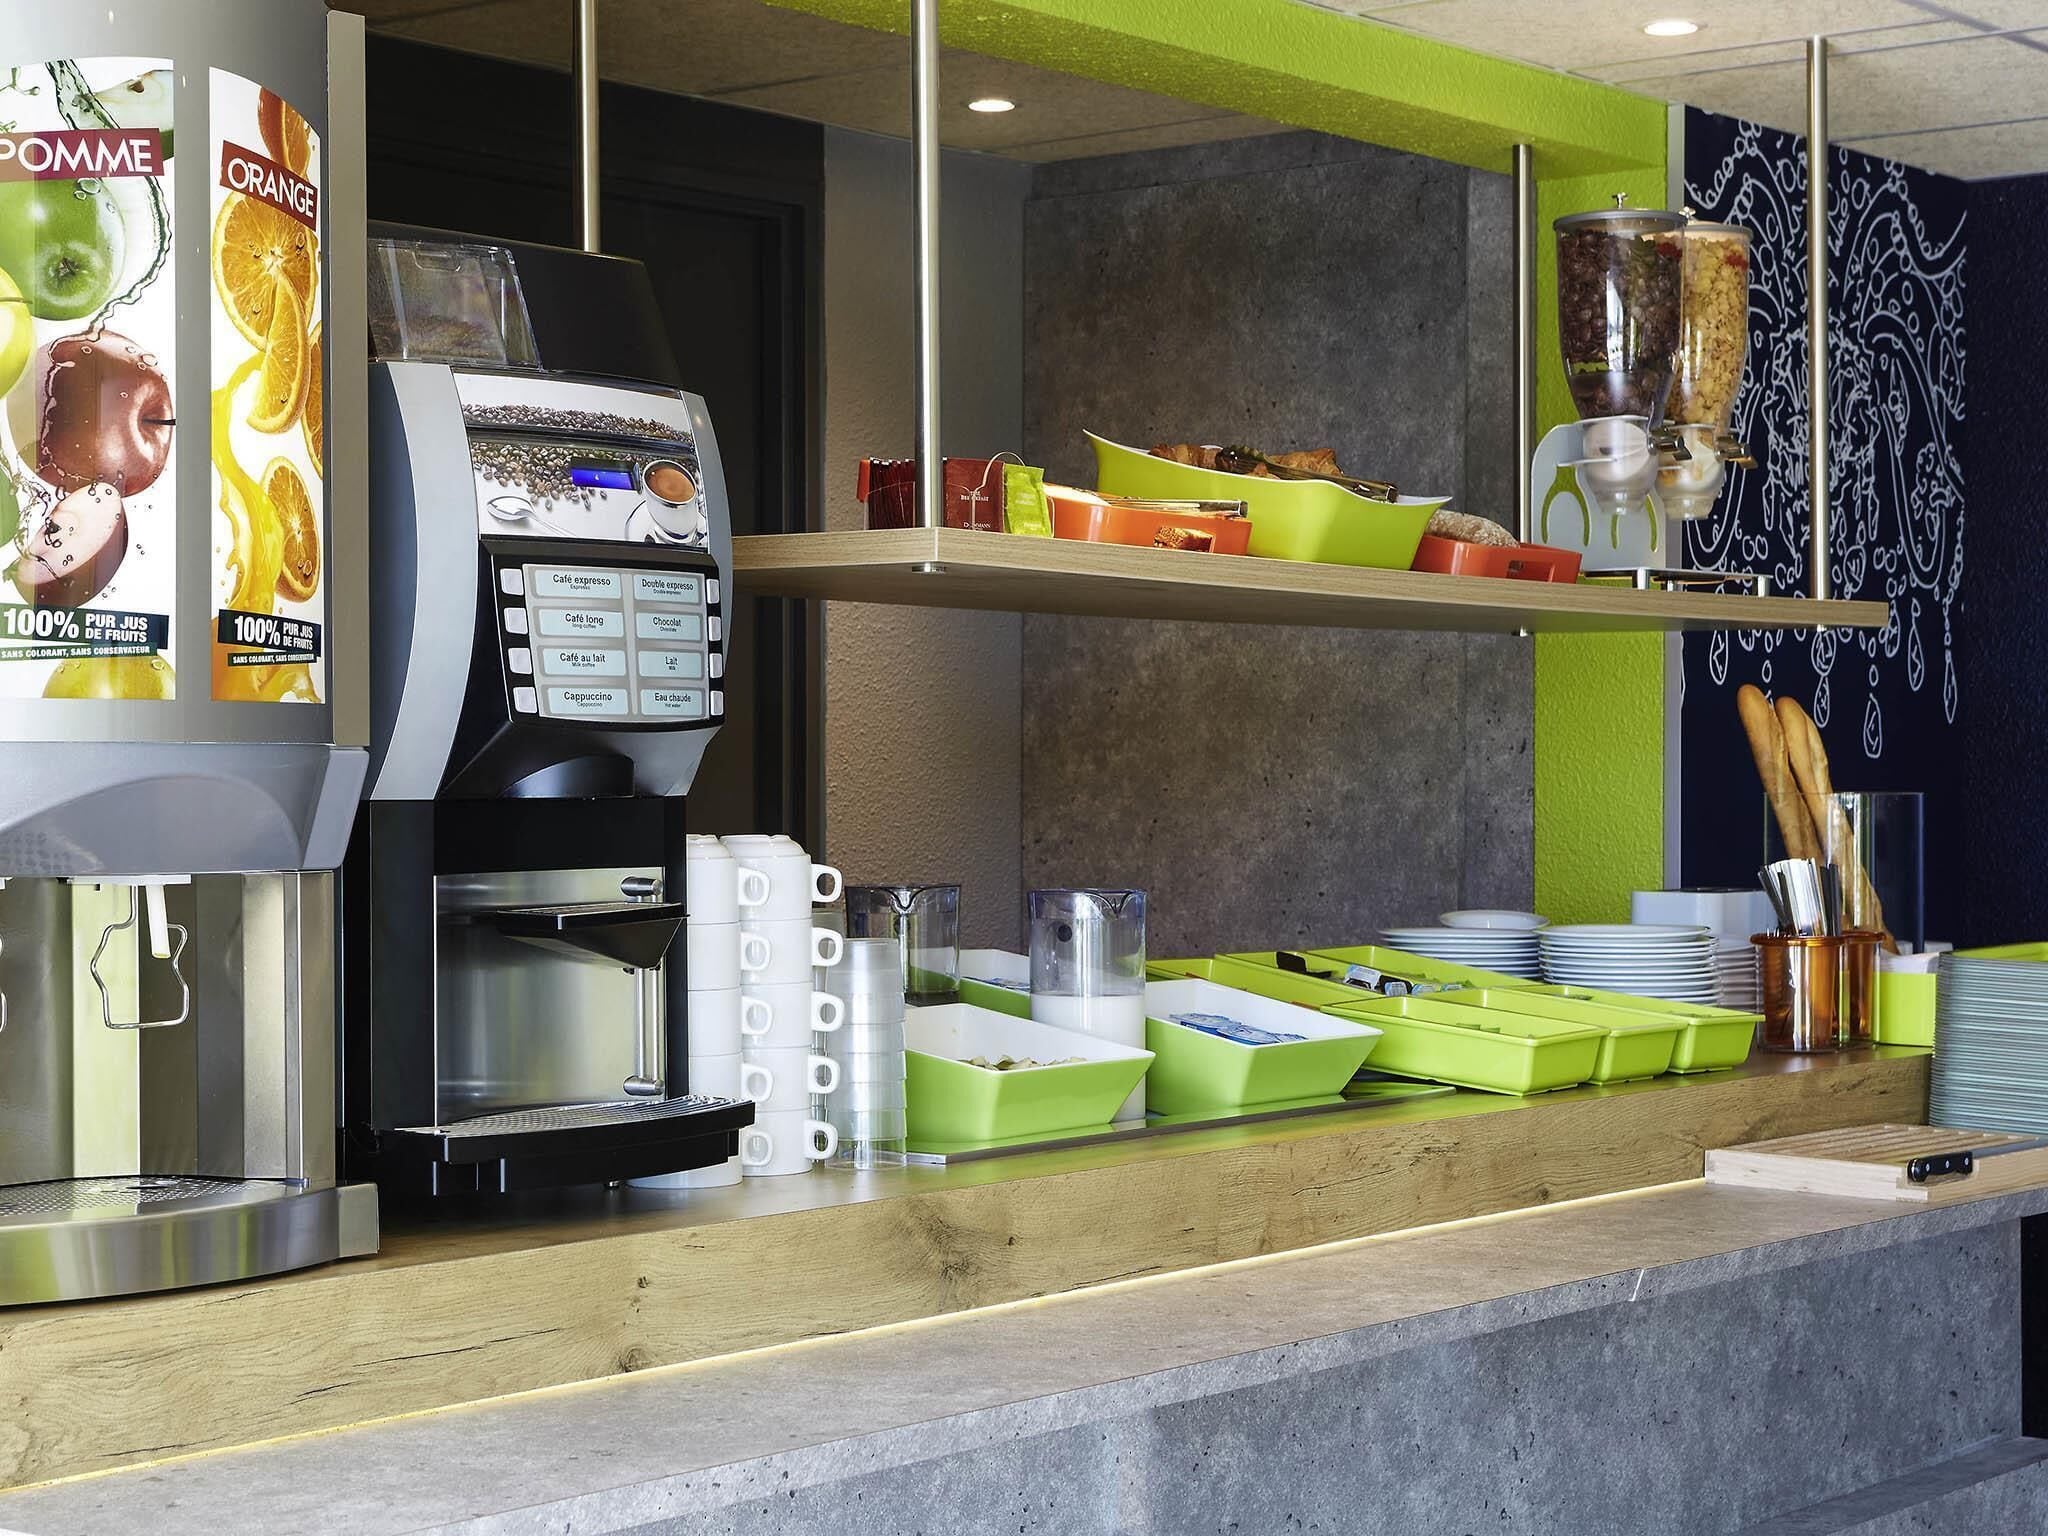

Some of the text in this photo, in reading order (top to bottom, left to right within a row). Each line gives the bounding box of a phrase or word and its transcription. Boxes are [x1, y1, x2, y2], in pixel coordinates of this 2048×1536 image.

[227, 157, 314, 218] ORANGE
[553, 574, 611, 587] Café expresso
[642, 578, 694, 591] Double expresso
[4, 608, 79, 639] 100%
[85, 613, 148, 631] PUR JUS
[565, 613, 604, 627] Café long
[652, 616, 682, 627] Chocolat
[85, 629, 148, 643] DE FRUITS
[234, 615, 281, 646] 100%
[283, 622, 313, 639] PUR JUS
[283, 635, 313, 651] DE FRUITS
[2, 645, 150, 658] SANS COLORANT, SANS CONSERVATEUR
[560, 652, 606, 663] Café au lait
[232, 655, 248, 664] SANS
[665, 655, 678, 666] Lait
[564, 691, 613, 703] Cappuccino
[655, 692, 692, 702] Eau chaude
